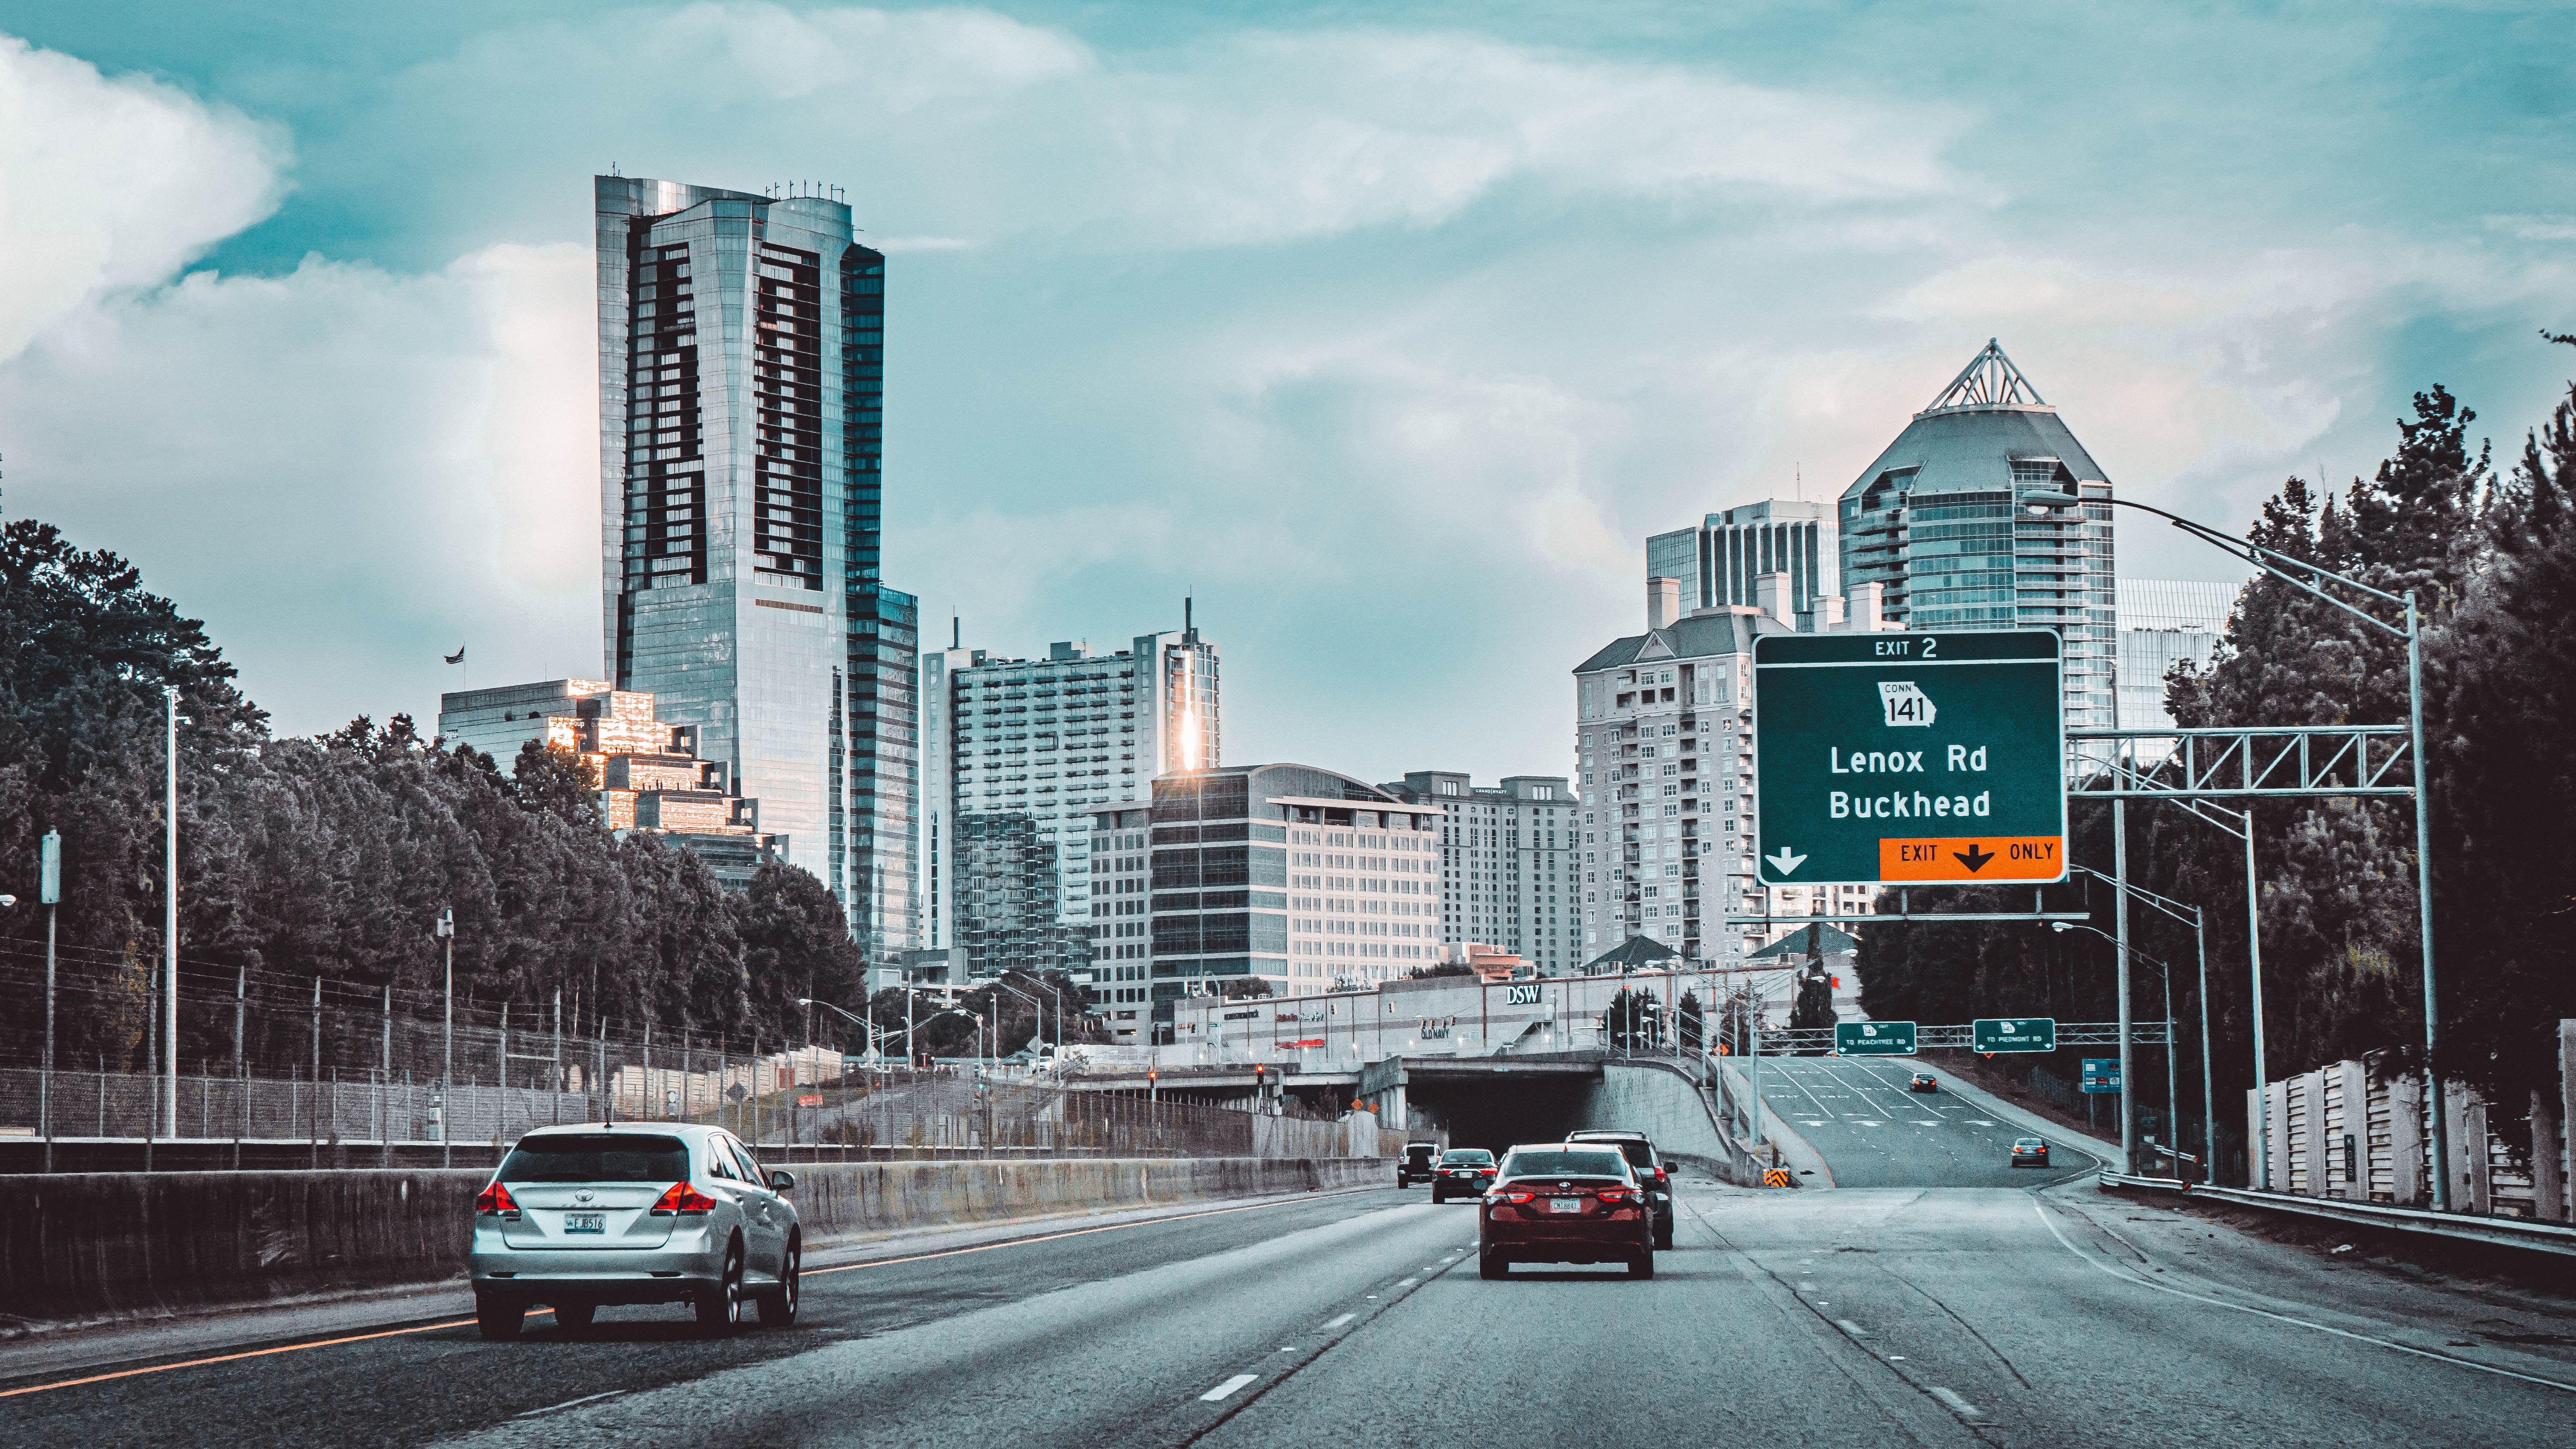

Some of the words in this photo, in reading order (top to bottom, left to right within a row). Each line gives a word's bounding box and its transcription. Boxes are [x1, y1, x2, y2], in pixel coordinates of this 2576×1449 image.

[1875, 641, 1910, 655] EXIT
[1922, 637, 1937, 658] 2
[1885, 684, 1911, 692] CONN
[1889, 697, 1923, 721] 141
[1831, 746, 1924, 773] Lenox
[1947, 745, 1987, 771] Rd
[1830, 791, 1990, 818] Buckhead
[1902, 845, 1937, 861] EXIT
[2010, 843, 2053, 860] ONLY
[1507, 985, 1539, 1003] DSW
[1421, 1029, 1433, 1039] OLD
[1433, 1028, 1449, 1039] NAVY
